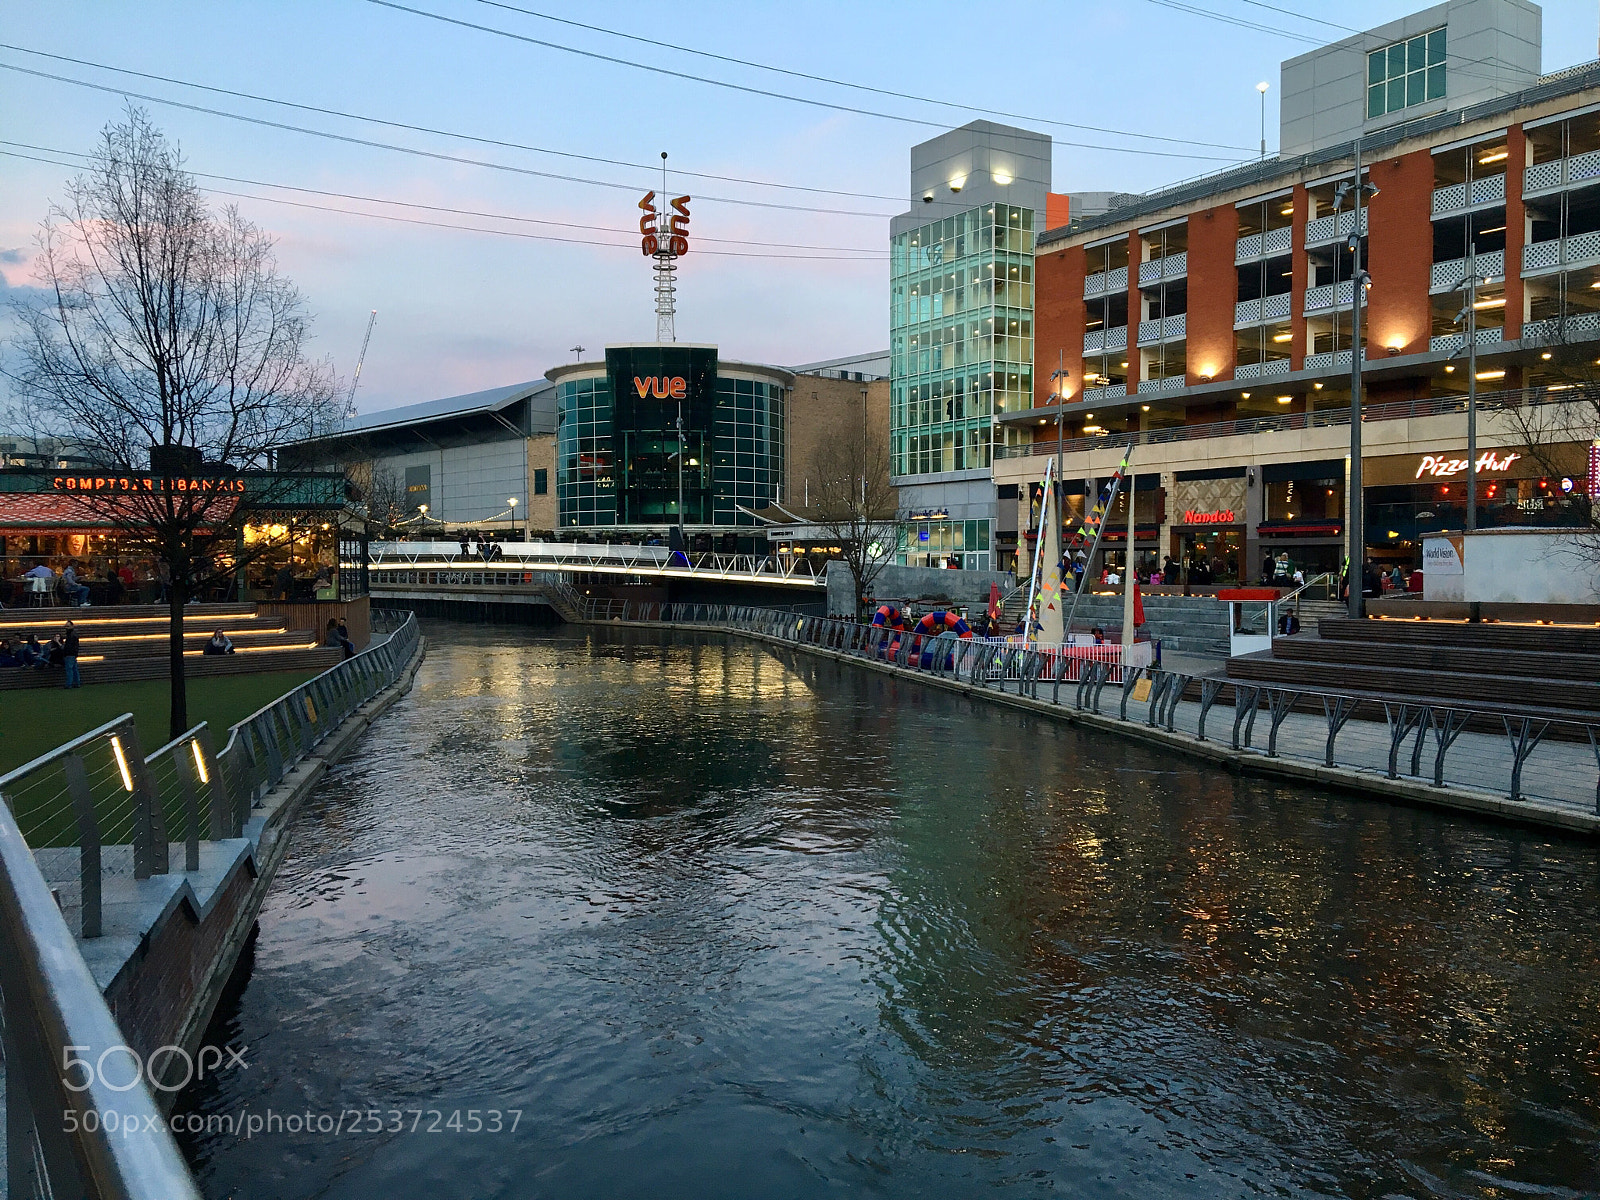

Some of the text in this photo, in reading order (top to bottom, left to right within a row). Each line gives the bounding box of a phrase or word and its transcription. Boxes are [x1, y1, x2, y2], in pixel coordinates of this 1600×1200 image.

[1415, 451, 1522, 479] Pizza Hut
[1184, 508, 1234, 524] Nando's
[1426, 547, 1454, 559] World Vision
